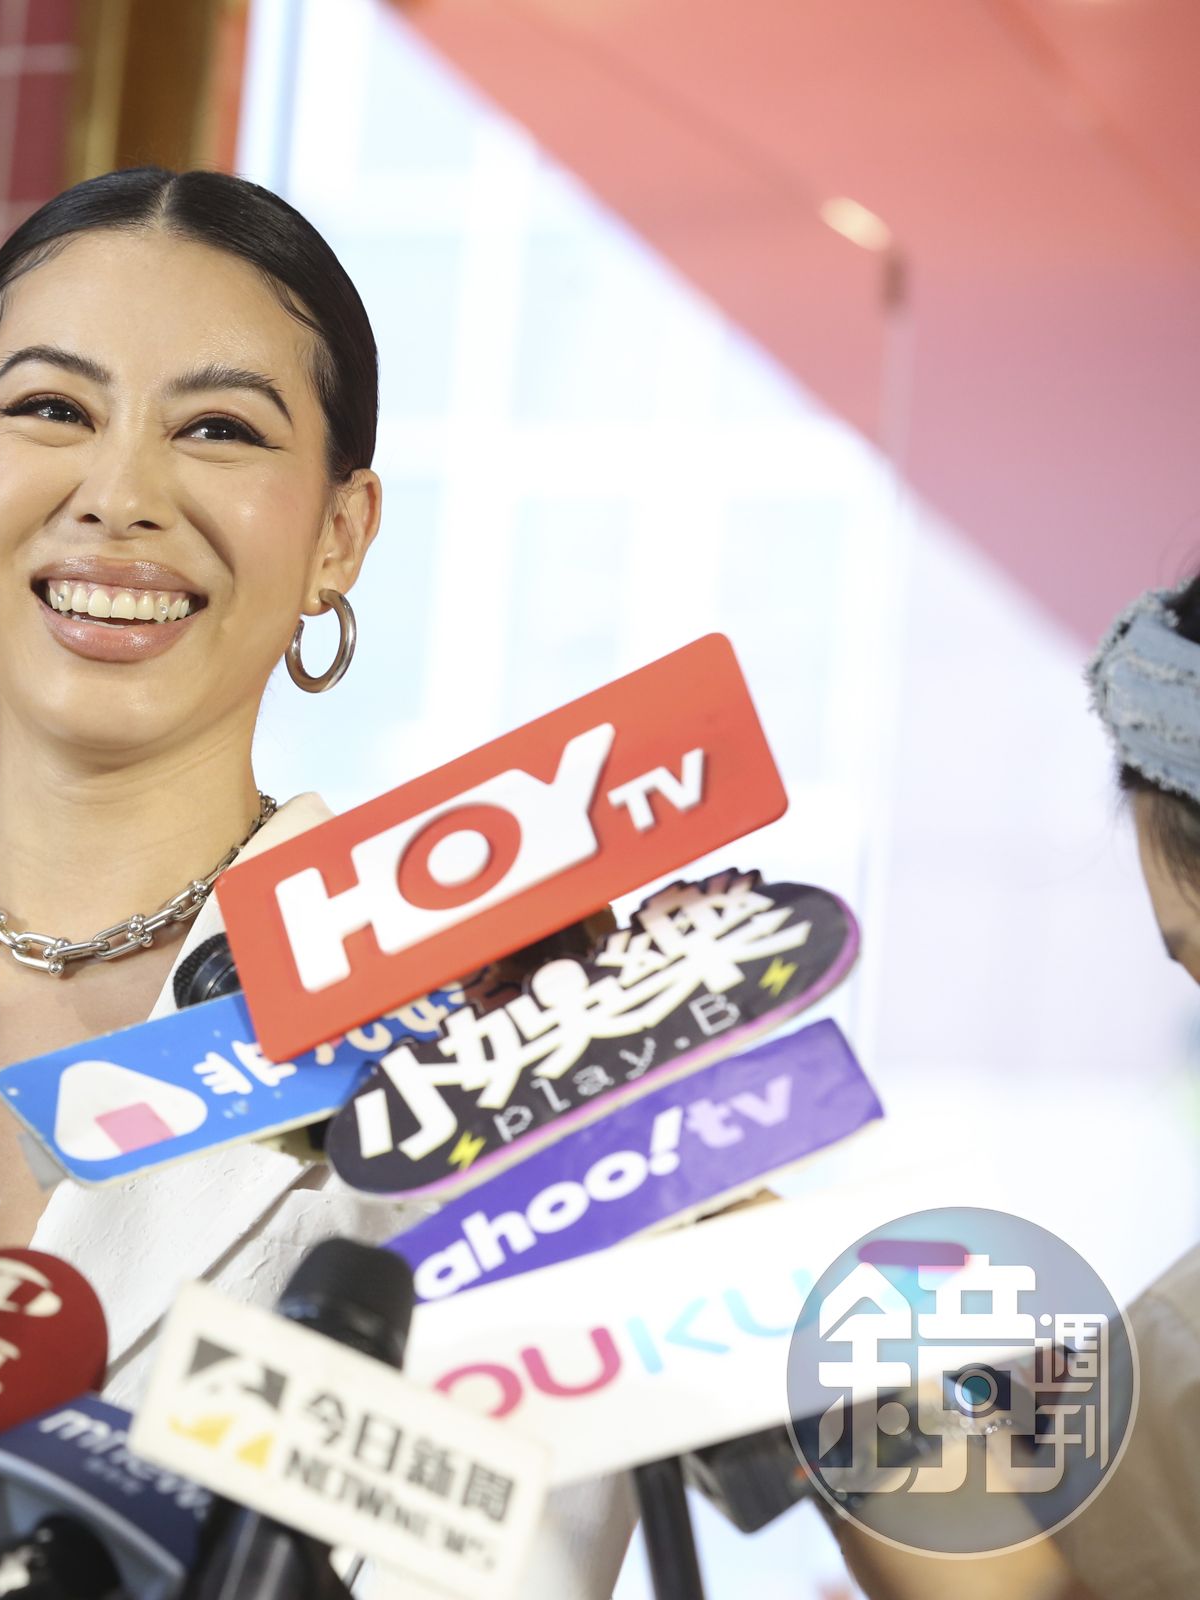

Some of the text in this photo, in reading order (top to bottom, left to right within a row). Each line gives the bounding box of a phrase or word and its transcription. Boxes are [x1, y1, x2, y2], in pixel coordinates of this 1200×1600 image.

[273, 722, 706, 993] HOY TV
[432, 1266, 822, 1421] OUKU
[305, 1389, 516, 1524] 今日新聞
